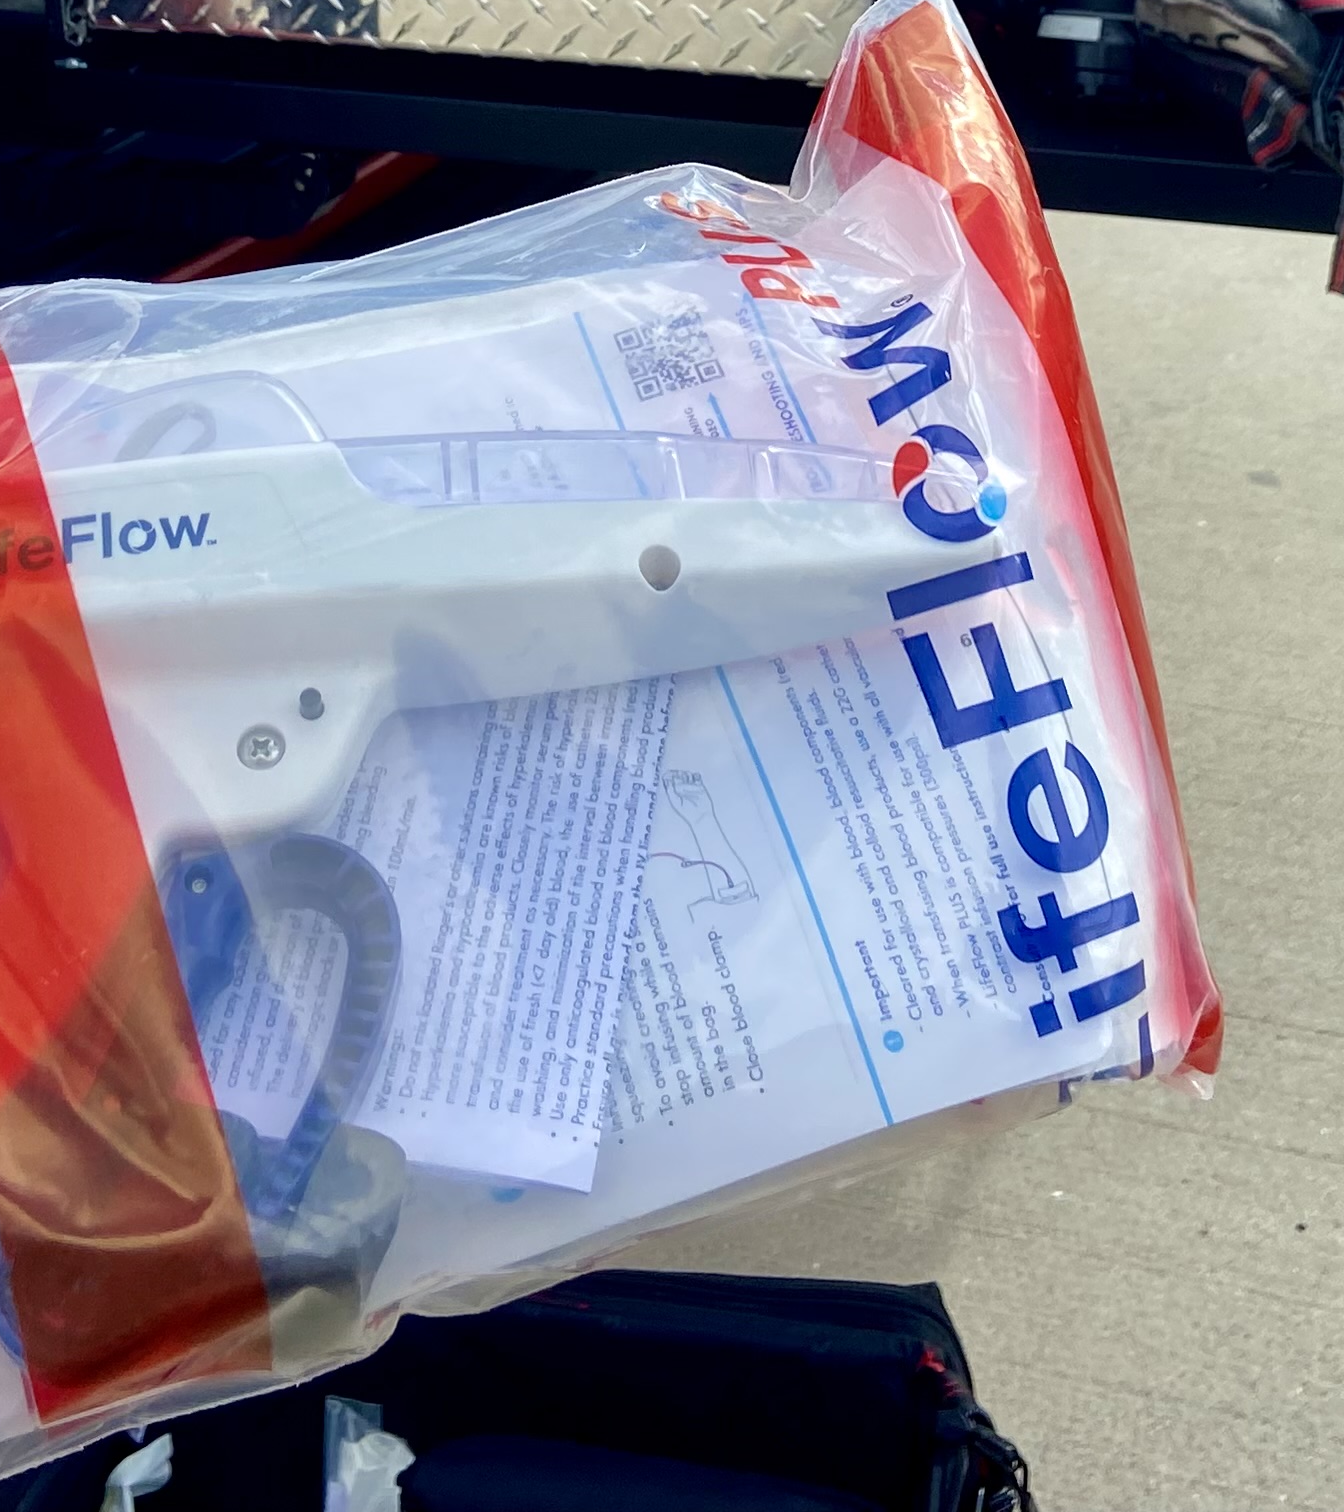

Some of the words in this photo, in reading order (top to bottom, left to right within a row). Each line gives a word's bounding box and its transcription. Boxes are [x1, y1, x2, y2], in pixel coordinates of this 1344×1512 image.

[863, 690, 880, 707] all
[854, 729, 870, 751] use
[873, 709, 893, 737] with
[629, 737, 649, 778] blood
[888, 740, 905, 762] use
[478, 823, 492, 848] are
[492, 742, 509, 772] risks
[816, 766, 842, 808] blood
[899, 766, 914, 787] for
[540, 799, 557, 823] The
[597, 801, 617, 845] blood
[618, 782, 645, 844] handling
[910, 790, 950, 872] compatible
[934, 794, 971, 862] pressures
[494, 811, 514, 859] effects
[855, 812, 885, 861] colloid
[890, 822, 918, 868] blood
[595, 847, 609, 877] and
[613, 847, 630, 885] when
[855, 861, 875, 894] with
[876, 864, 898, 895] and
[584, 880, 604, 925] blood
[871, 897, 887, 923] use
[913, 869, 950, 954] transfusing
[948, 891, 970, 929] PLUS
[963, 866, 991, 926] infusion
[536, 930, 557, 959] day
[643, 897, 669, 957] remains
[881, 928, 897, 951] for
[890, 899, 929, 979] crystalloid
[639, 957, 659, 998] while
[855, 940, 891, 1020] Important
[946, 958, 968, 1007] When
[967, 933, 997, 997] LifeFlow
[985, 930, 1016, 993] contrast
[659, 961, 686, 1010] blood
[720, 983, 747, 1032] blood
[888, 954, 922, 1020] Cleared
[920, 984, 943, 1016] and
[545, 1009, 560, 1040] and
[586, 981, 607, 1054] standard
[654, 1001, 681, 1064] infusing
[558, 1053, 577, 1087] only
[641, 1041, 666, 1089] avoid
[686, 1035, 714, 1097] amount
[712, 1044, 728, 1072] the
[742, 1035, 763, 1082] Close
[549, 1091, 567, 1120] Use
[570, 1059, 594, 1125] Practice
[675, 1068, 694, 1106] stop
